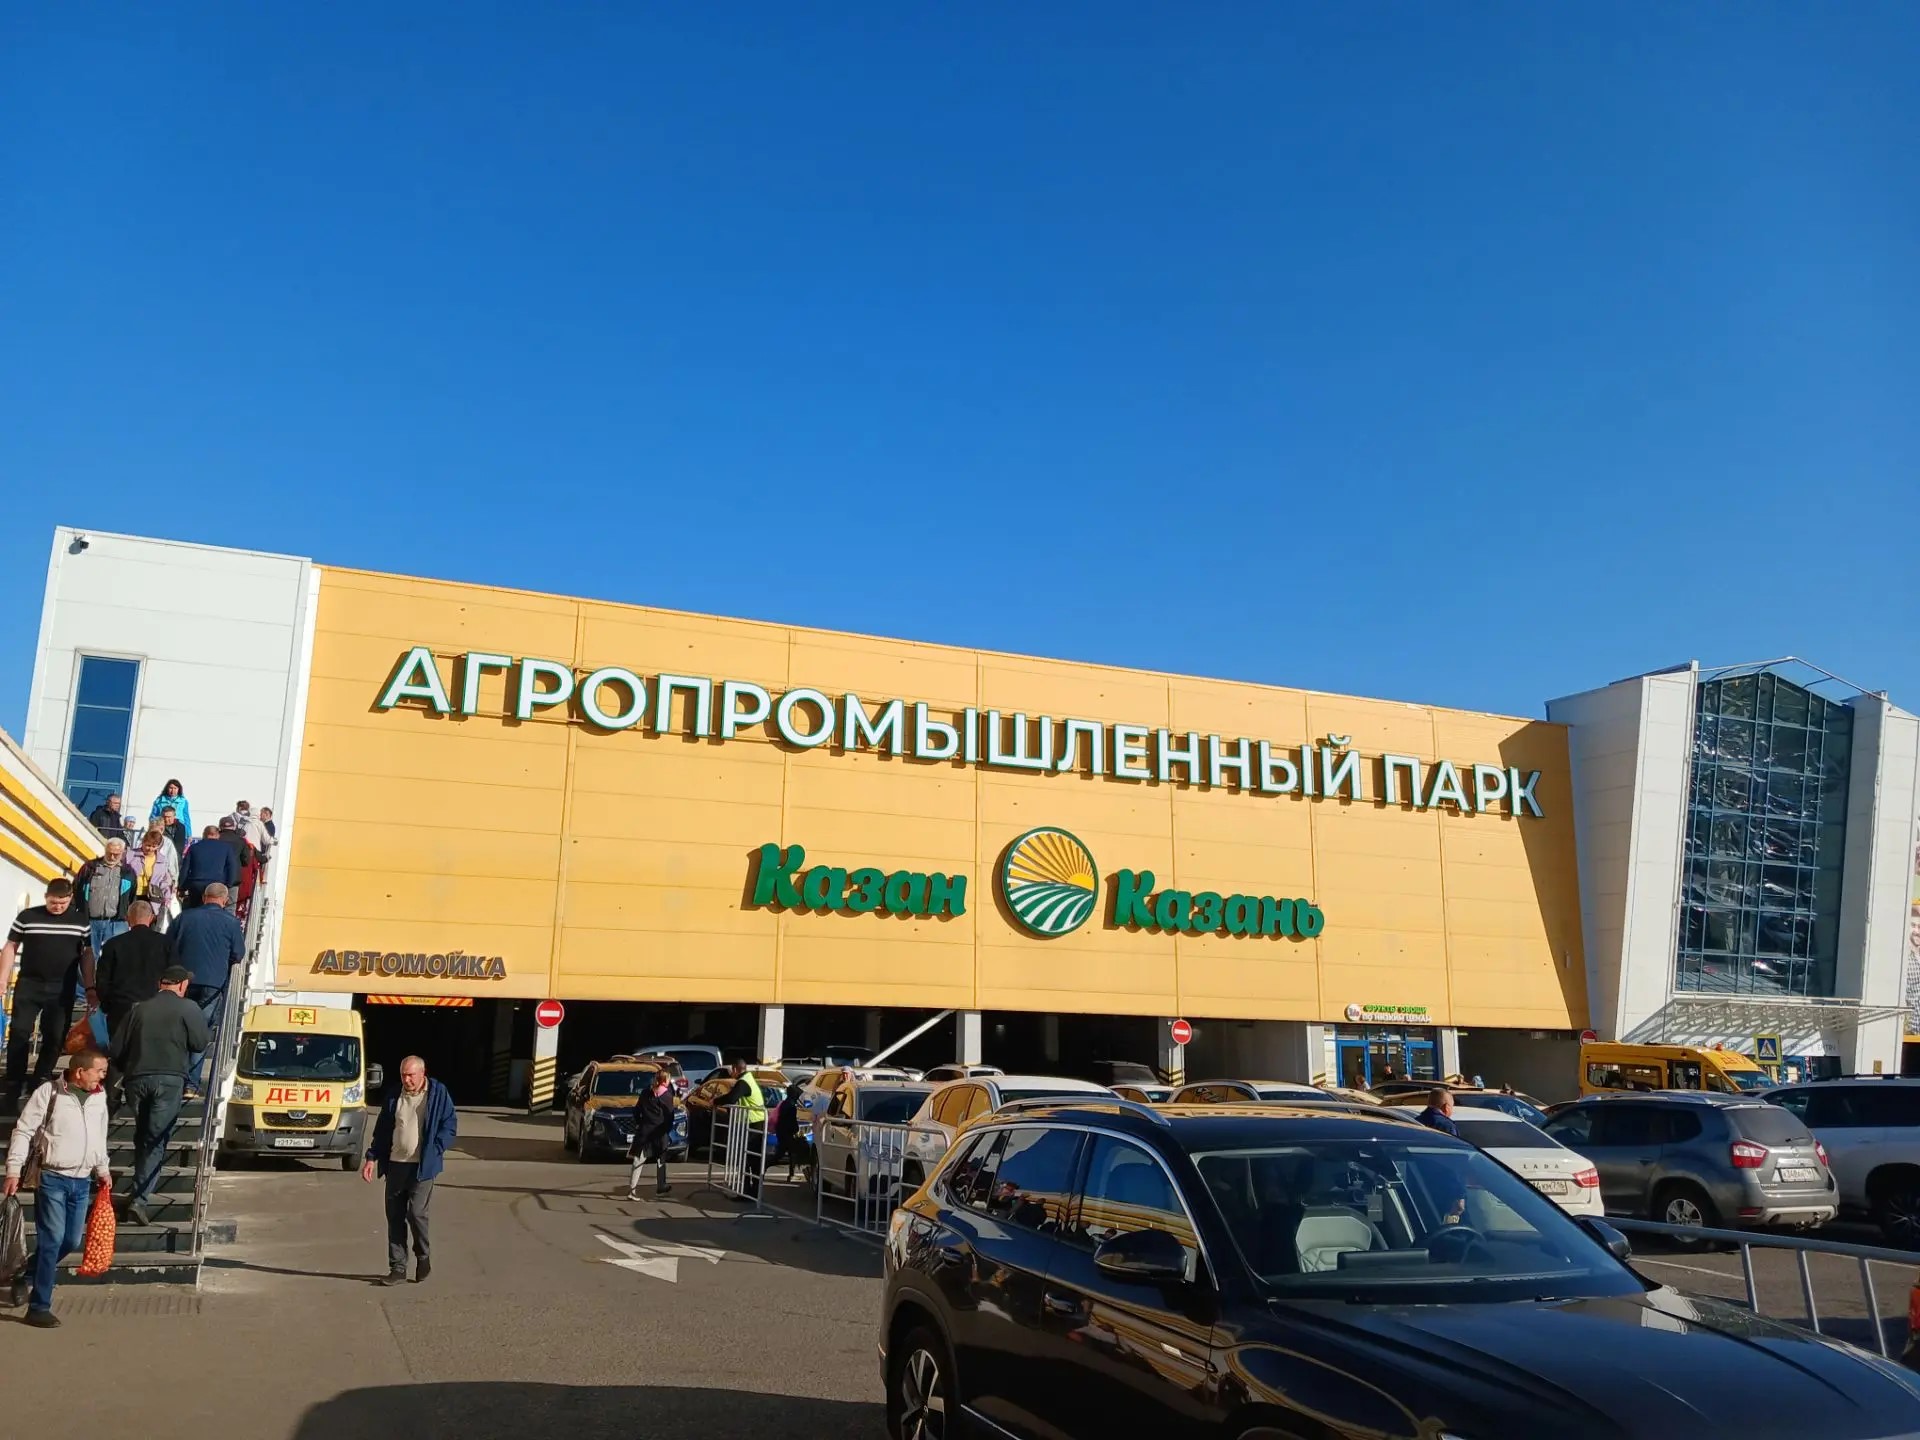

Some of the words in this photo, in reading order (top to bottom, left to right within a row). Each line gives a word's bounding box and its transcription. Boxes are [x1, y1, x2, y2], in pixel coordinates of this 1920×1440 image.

[380, 646, 1362, 801] АГРОПРОМЫШЛЕННЫЙ
[1382, 753, 1545, 818] ПАРК
[753, 842, 967, 917] Казан
[1113, 868, 1325, 938] Казань
[318, 949, 507, 977] АВТОМОЙКА
[265, 1087, 331, 1104] ДЕТИ
